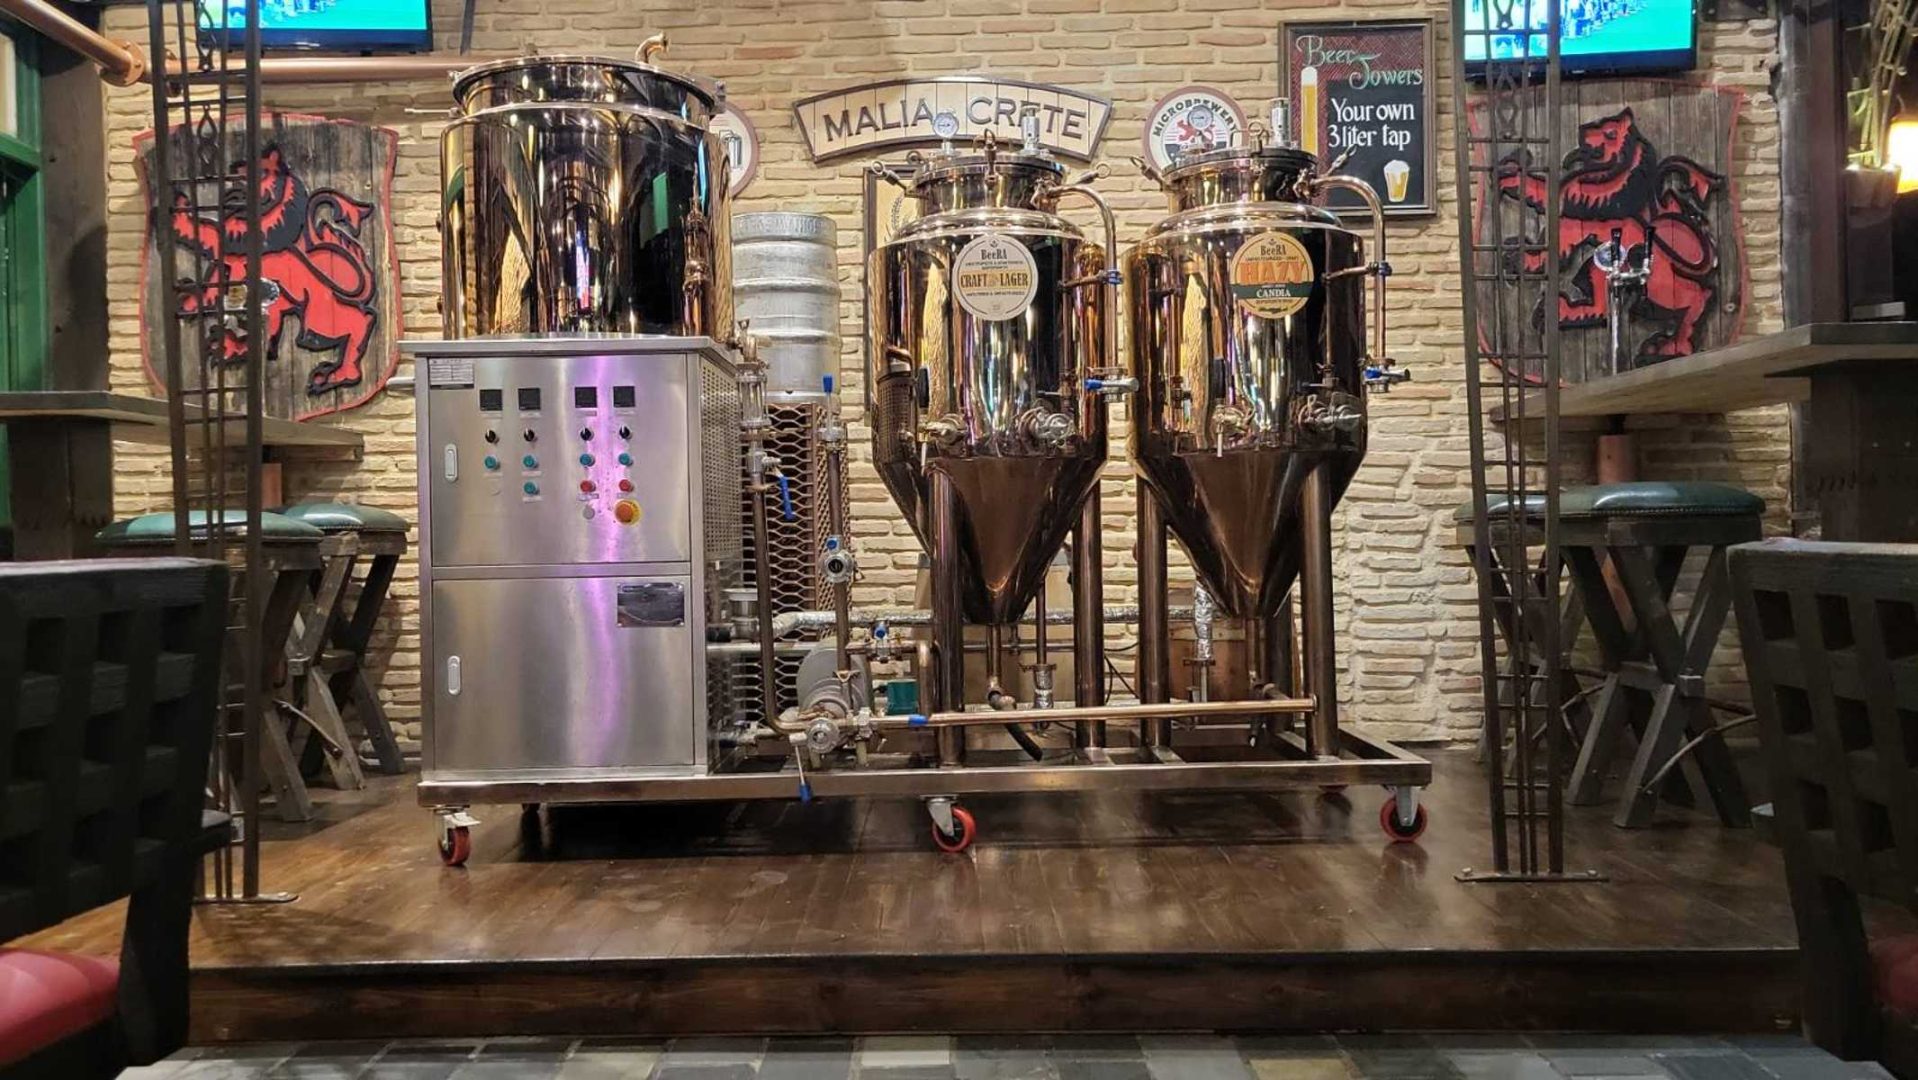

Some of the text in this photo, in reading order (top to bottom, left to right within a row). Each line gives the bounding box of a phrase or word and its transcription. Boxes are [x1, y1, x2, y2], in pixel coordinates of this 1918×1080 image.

[1295, 35, 1357, 67] Beer
[1349, 52, 1423, 90] Towers
[823, 97, 936, 142] MALIA
[1331, 97, 1415, 122] Your own
[1327, 124, 1411, 151] 3 liter tap
[960, 272, 1029, 288] CRAFT LAGER
[1256, 288, 1291, 298] CANDIA
